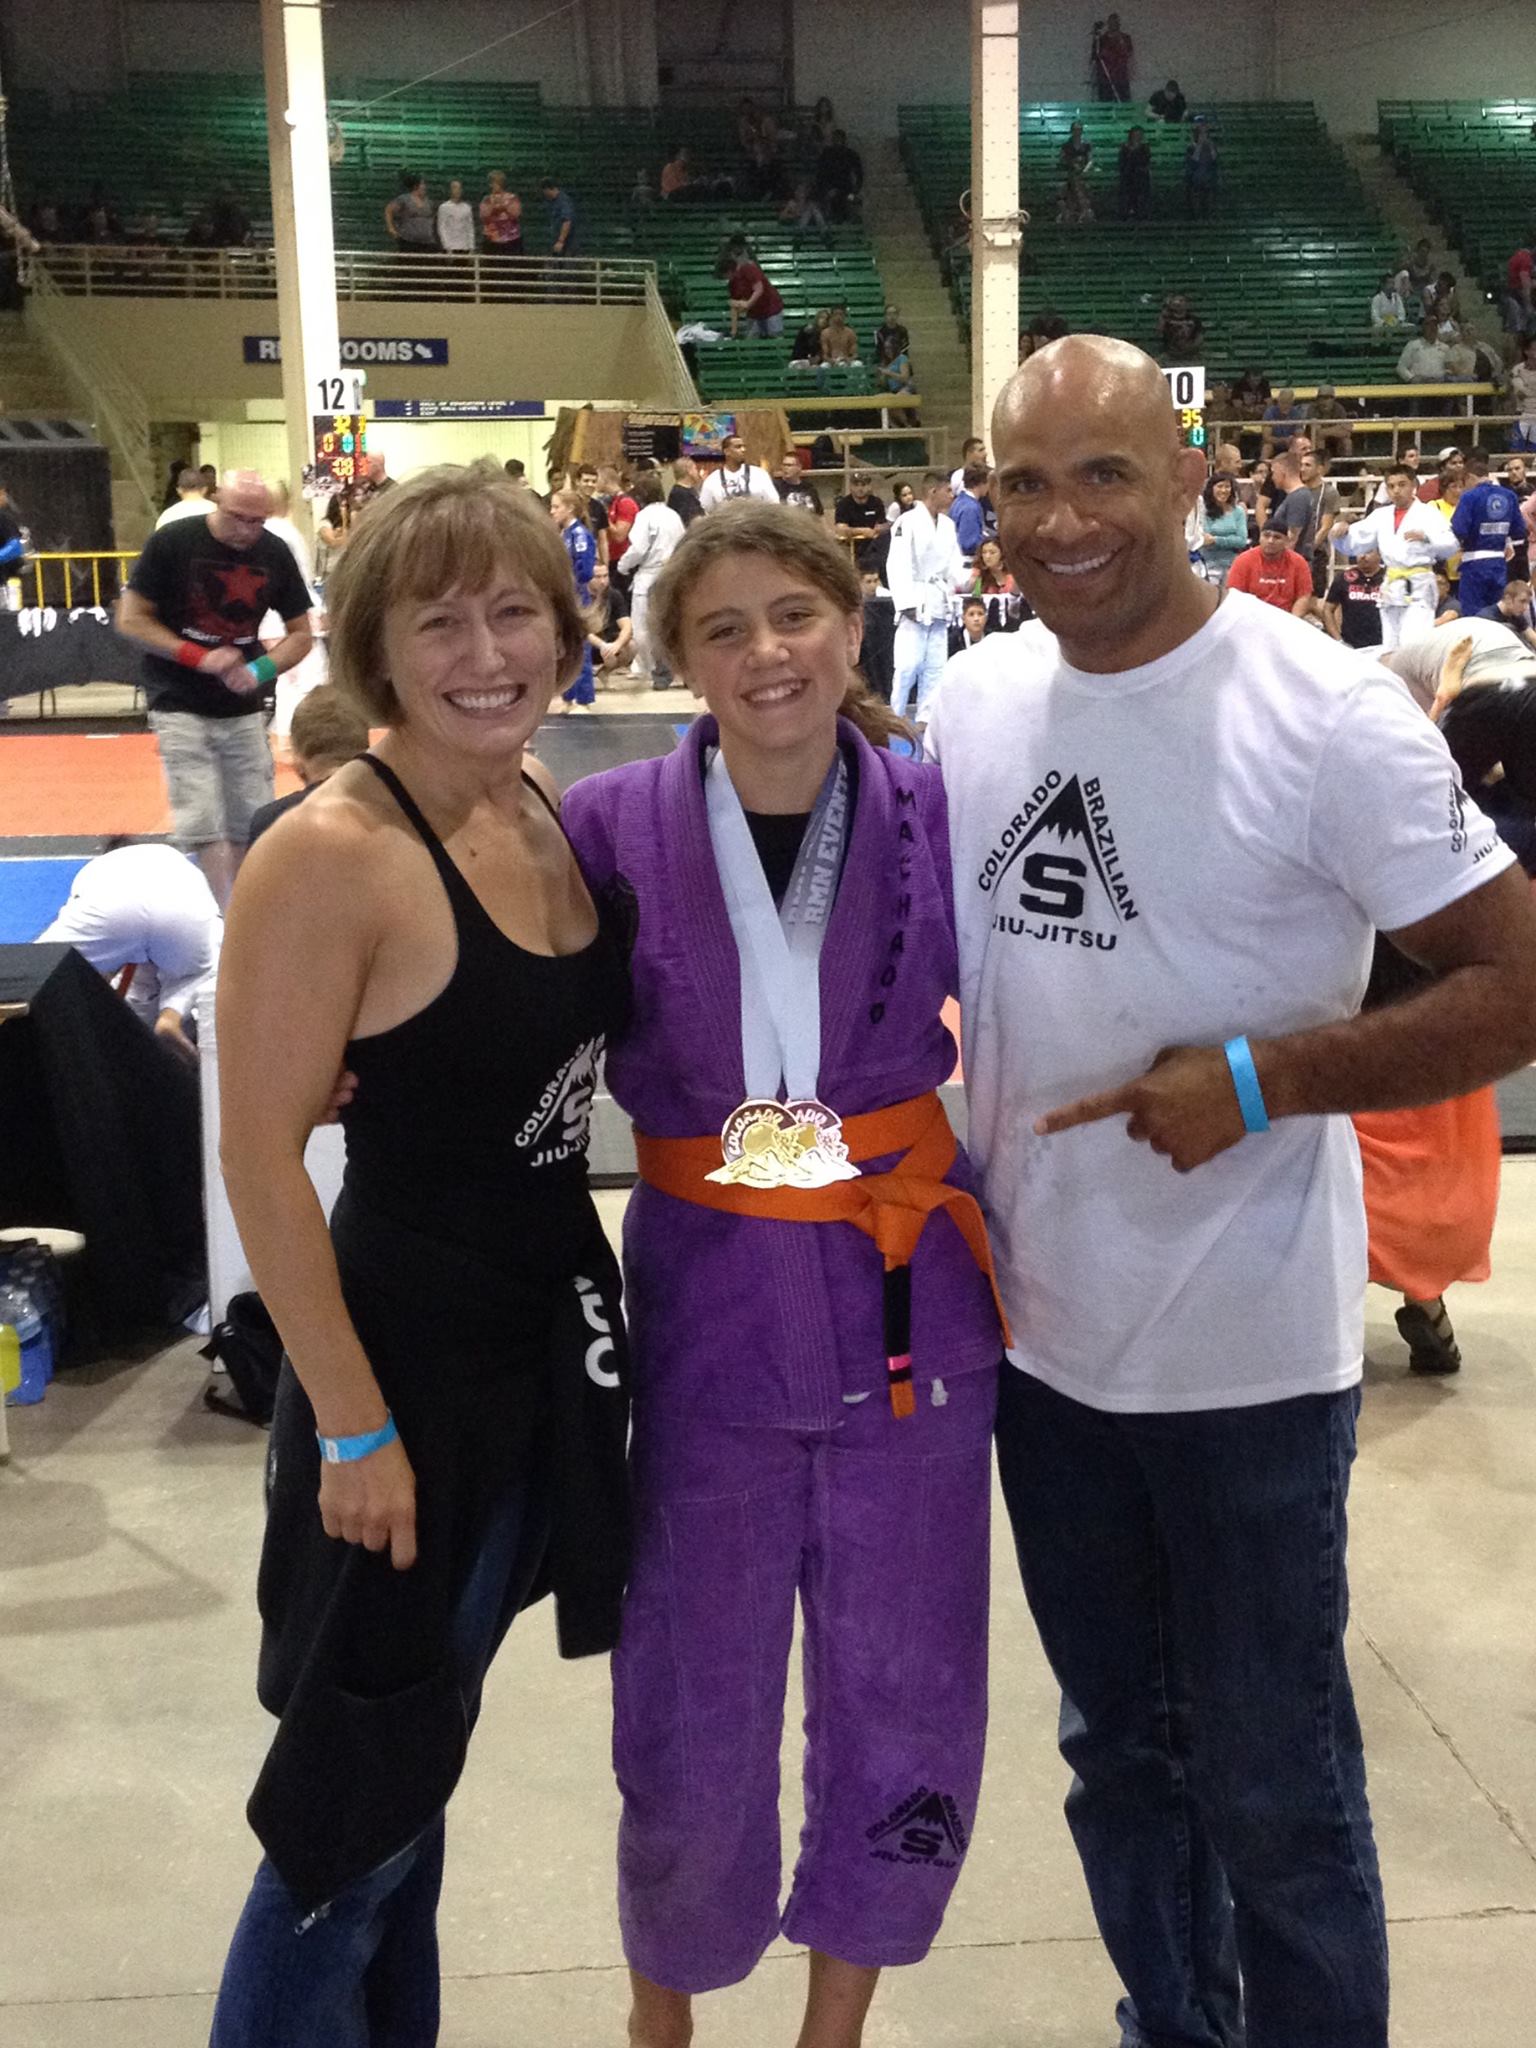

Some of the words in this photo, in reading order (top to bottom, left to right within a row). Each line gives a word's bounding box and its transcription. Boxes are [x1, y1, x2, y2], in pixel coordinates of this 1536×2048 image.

[318, 378, 345, 410] 12
[978, 770, 1061, 892] COLORADO
[1083, 777, 1139, 921] BRAZILIAN
[804, 864, 833, 925] RMN
[869, 787, 917, 1024] MACHADO
[1019, 852, 1087, 919] S
[992, 914, 1117, 951] JIU-JITSU
[728, 1108, 784, 1156] COLORADO
[900, 1827, 944, 1856] S
